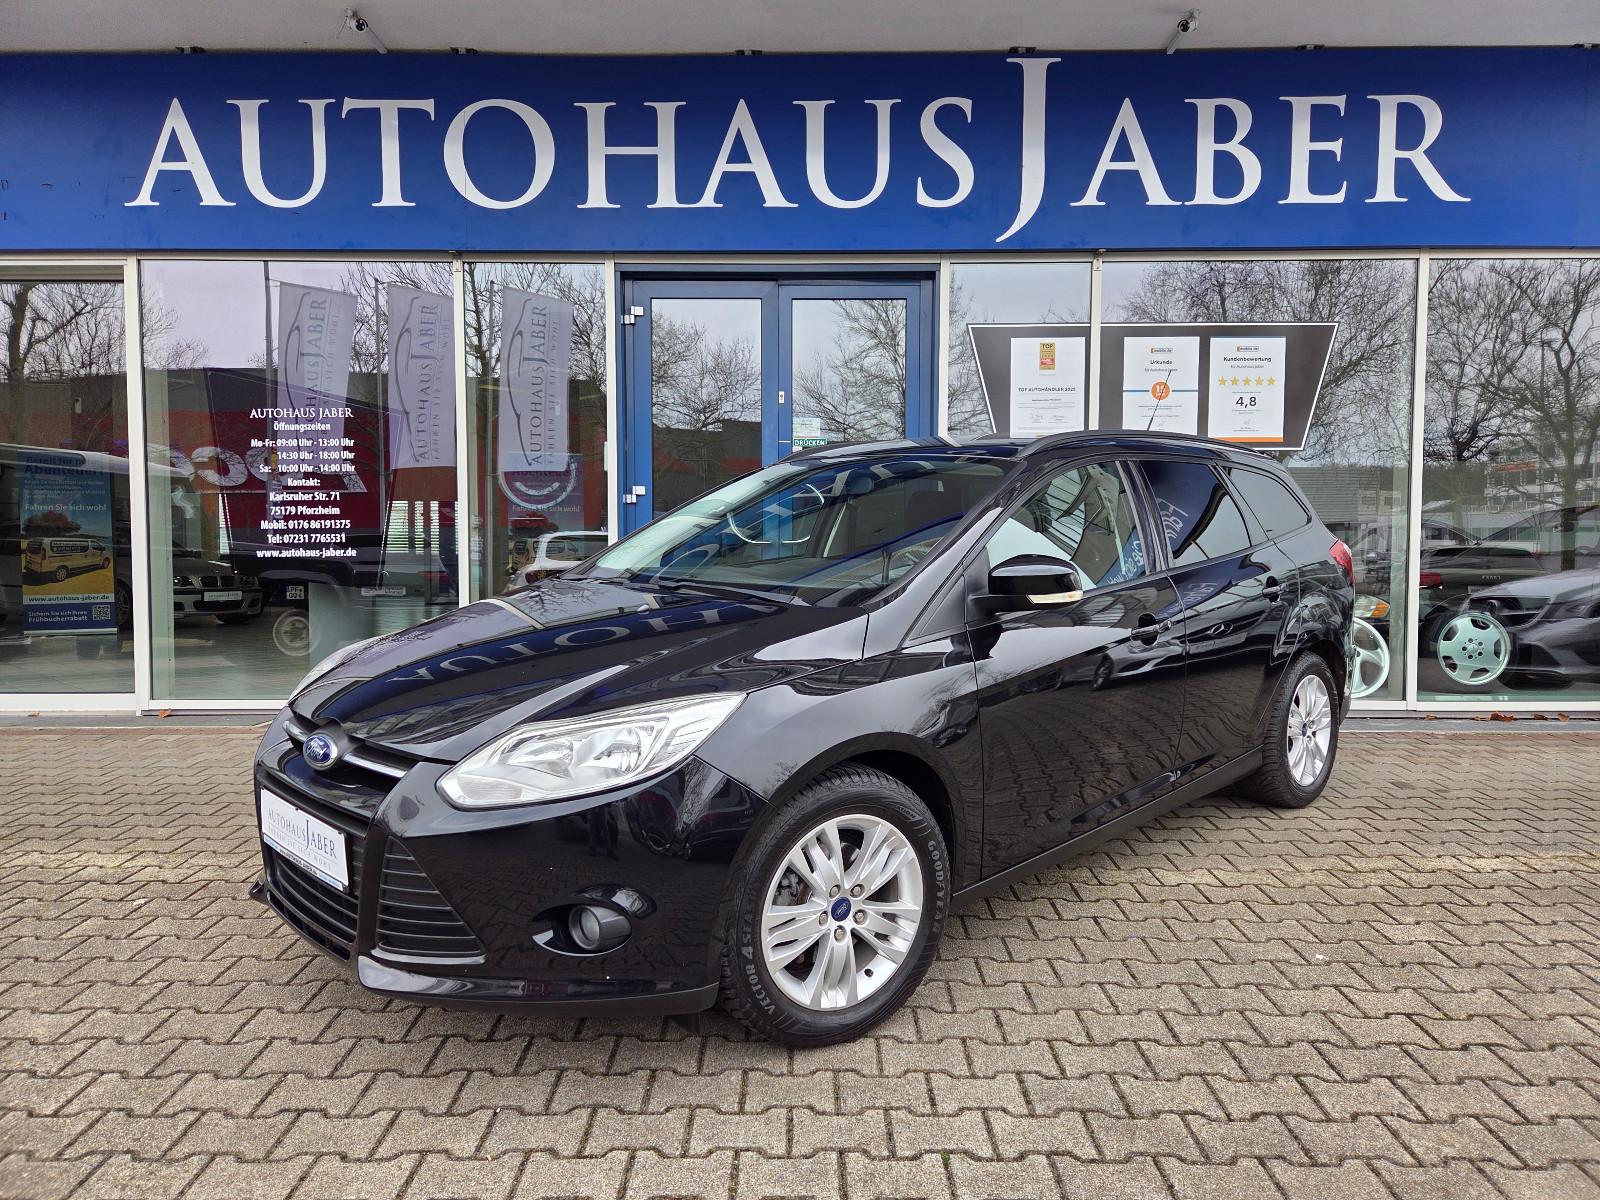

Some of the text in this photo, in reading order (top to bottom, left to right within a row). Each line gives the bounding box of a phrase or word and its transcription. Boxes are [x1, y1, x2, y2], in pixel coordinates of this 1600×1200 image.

[1235, 396, 1257, 408] 4,8
[249, 407, 354, 420] AUTOHAUS JABER
[273, 420, 331, 433] Öffnungszeiten
[250, 438, 276, 448] Mo-Fr:
[276, 438, 298, 447] 09:00
[299, 438, 314, 447] Uhr
[319, 438, 340, 447] 13:00
[340, 438, 355, 447] Uhr
[794, 438, 825, 446] DRÜCKEN
[277, 451, 299, 460] 14:30
[299, 451, 314, 460] Uhr
[319, 451, 340, 460] 18:00
[341, 451, 355, 460] Uhr
[259, 464, 272, 473] Sa:
[277, 464, 299, 473] 10:00
[299, 464, 314, 473] Uhr
[319, 464, 341, 473] 14:00
[341, 463, 356, 472] Uhr
[287, 477, 321, 487] Kontakt:
[269, 491, 340, 501] Karlsruher Str. 71
[87, 503, 107, 511] wohl
[270, 505, 341, 515] 75179 Pforzheim
[260, 520, 351, 530] Mobil: 0176 86191375
[267, 533, 346, 543] Tel: 07231 7765531
[256, 547, 357, 558] www.autohaus-jaber.de
[28, 594, 110, 603] www.autohaus-jaber.de
[28, 615, 88, 624] Frühbucherrabatt
[268, 807, 338, 859] AUTOHAUS JABER
[927, 840, 945, 935] GOODYEAR
[745, 963, 776, 1015] VECTOR
